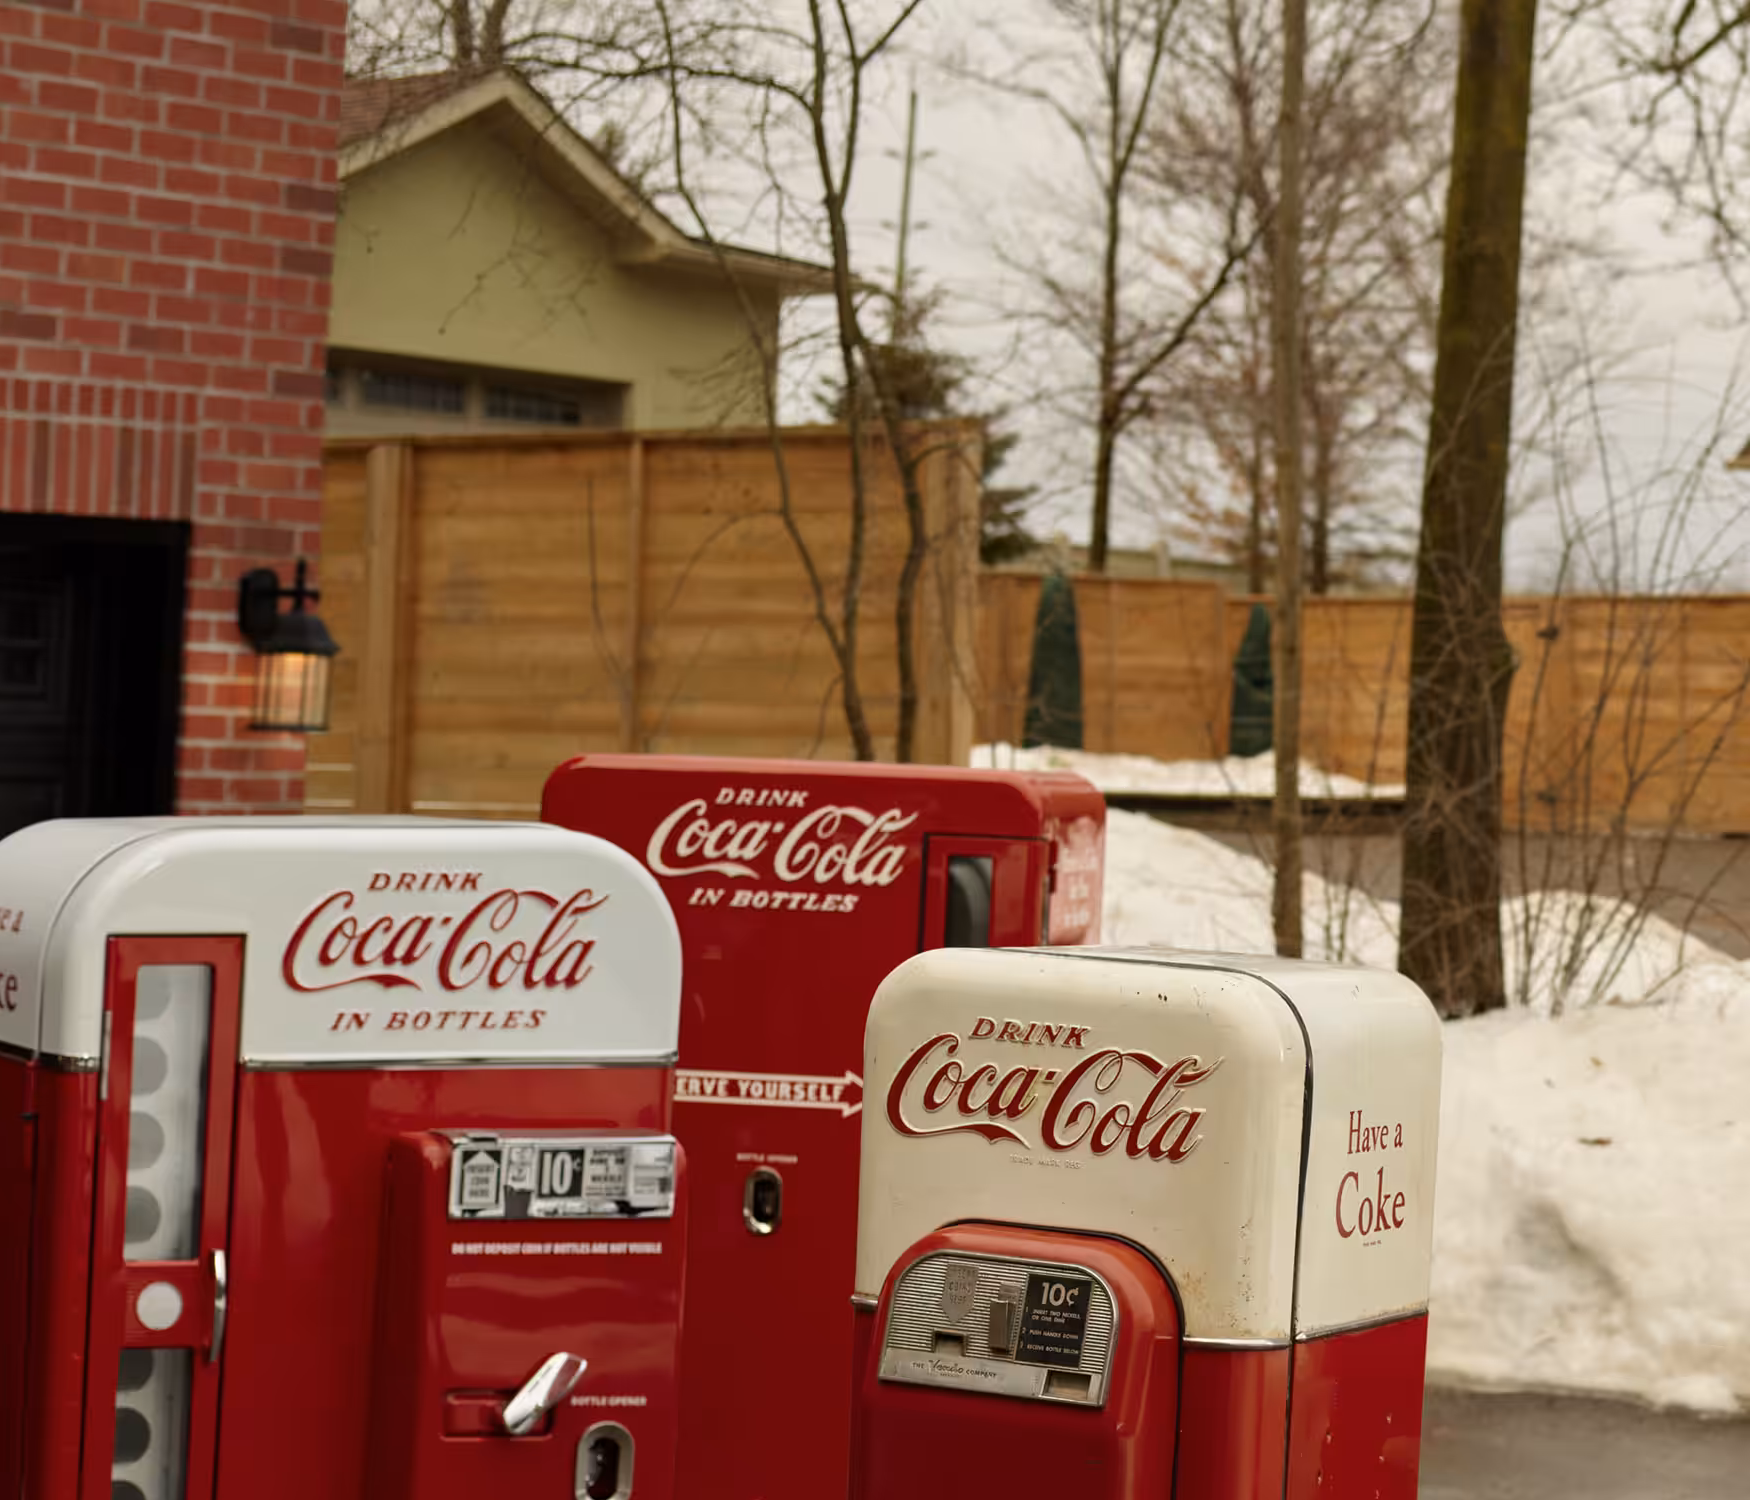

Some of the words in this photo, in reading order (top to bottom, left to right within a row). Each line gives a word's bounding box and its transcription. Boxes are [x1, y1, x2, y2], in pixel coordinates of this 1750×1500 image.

[716, 787, 809, 808] DRINK
[646, 798, 919, 887] Coca-Cola
[367, 872, 483, 893] DRINK
[689, 887, 723, 907] IN
[730, 889, 859, 914] BOTTLES
[282, 888, 610, 994] Coca-Cola
[331, 1012, 369, 1033] IN
[385, 1009, 548, 1032] BOTTLES
[967, 1016, 1091, 1049] DRINK
[676, 1077, 729, 1098] ERVE
[737, 1080, 845, 1102] YOURSELF
[886, 1032, 1225, 1164] Coca-Cola
[1347, 1110, 1388, 1154] Have
[1394, 1123, 1403, 1148] a
[1336, 1166, 1405, 1238] Coke
[1041, 1281, 1079, 1306] 10¢
[966, 1369, 997, 1378] COMPANY
[571, 1396, 607, 1407] BOTTLE
[608, 1396, 647, 1407] OPENER
